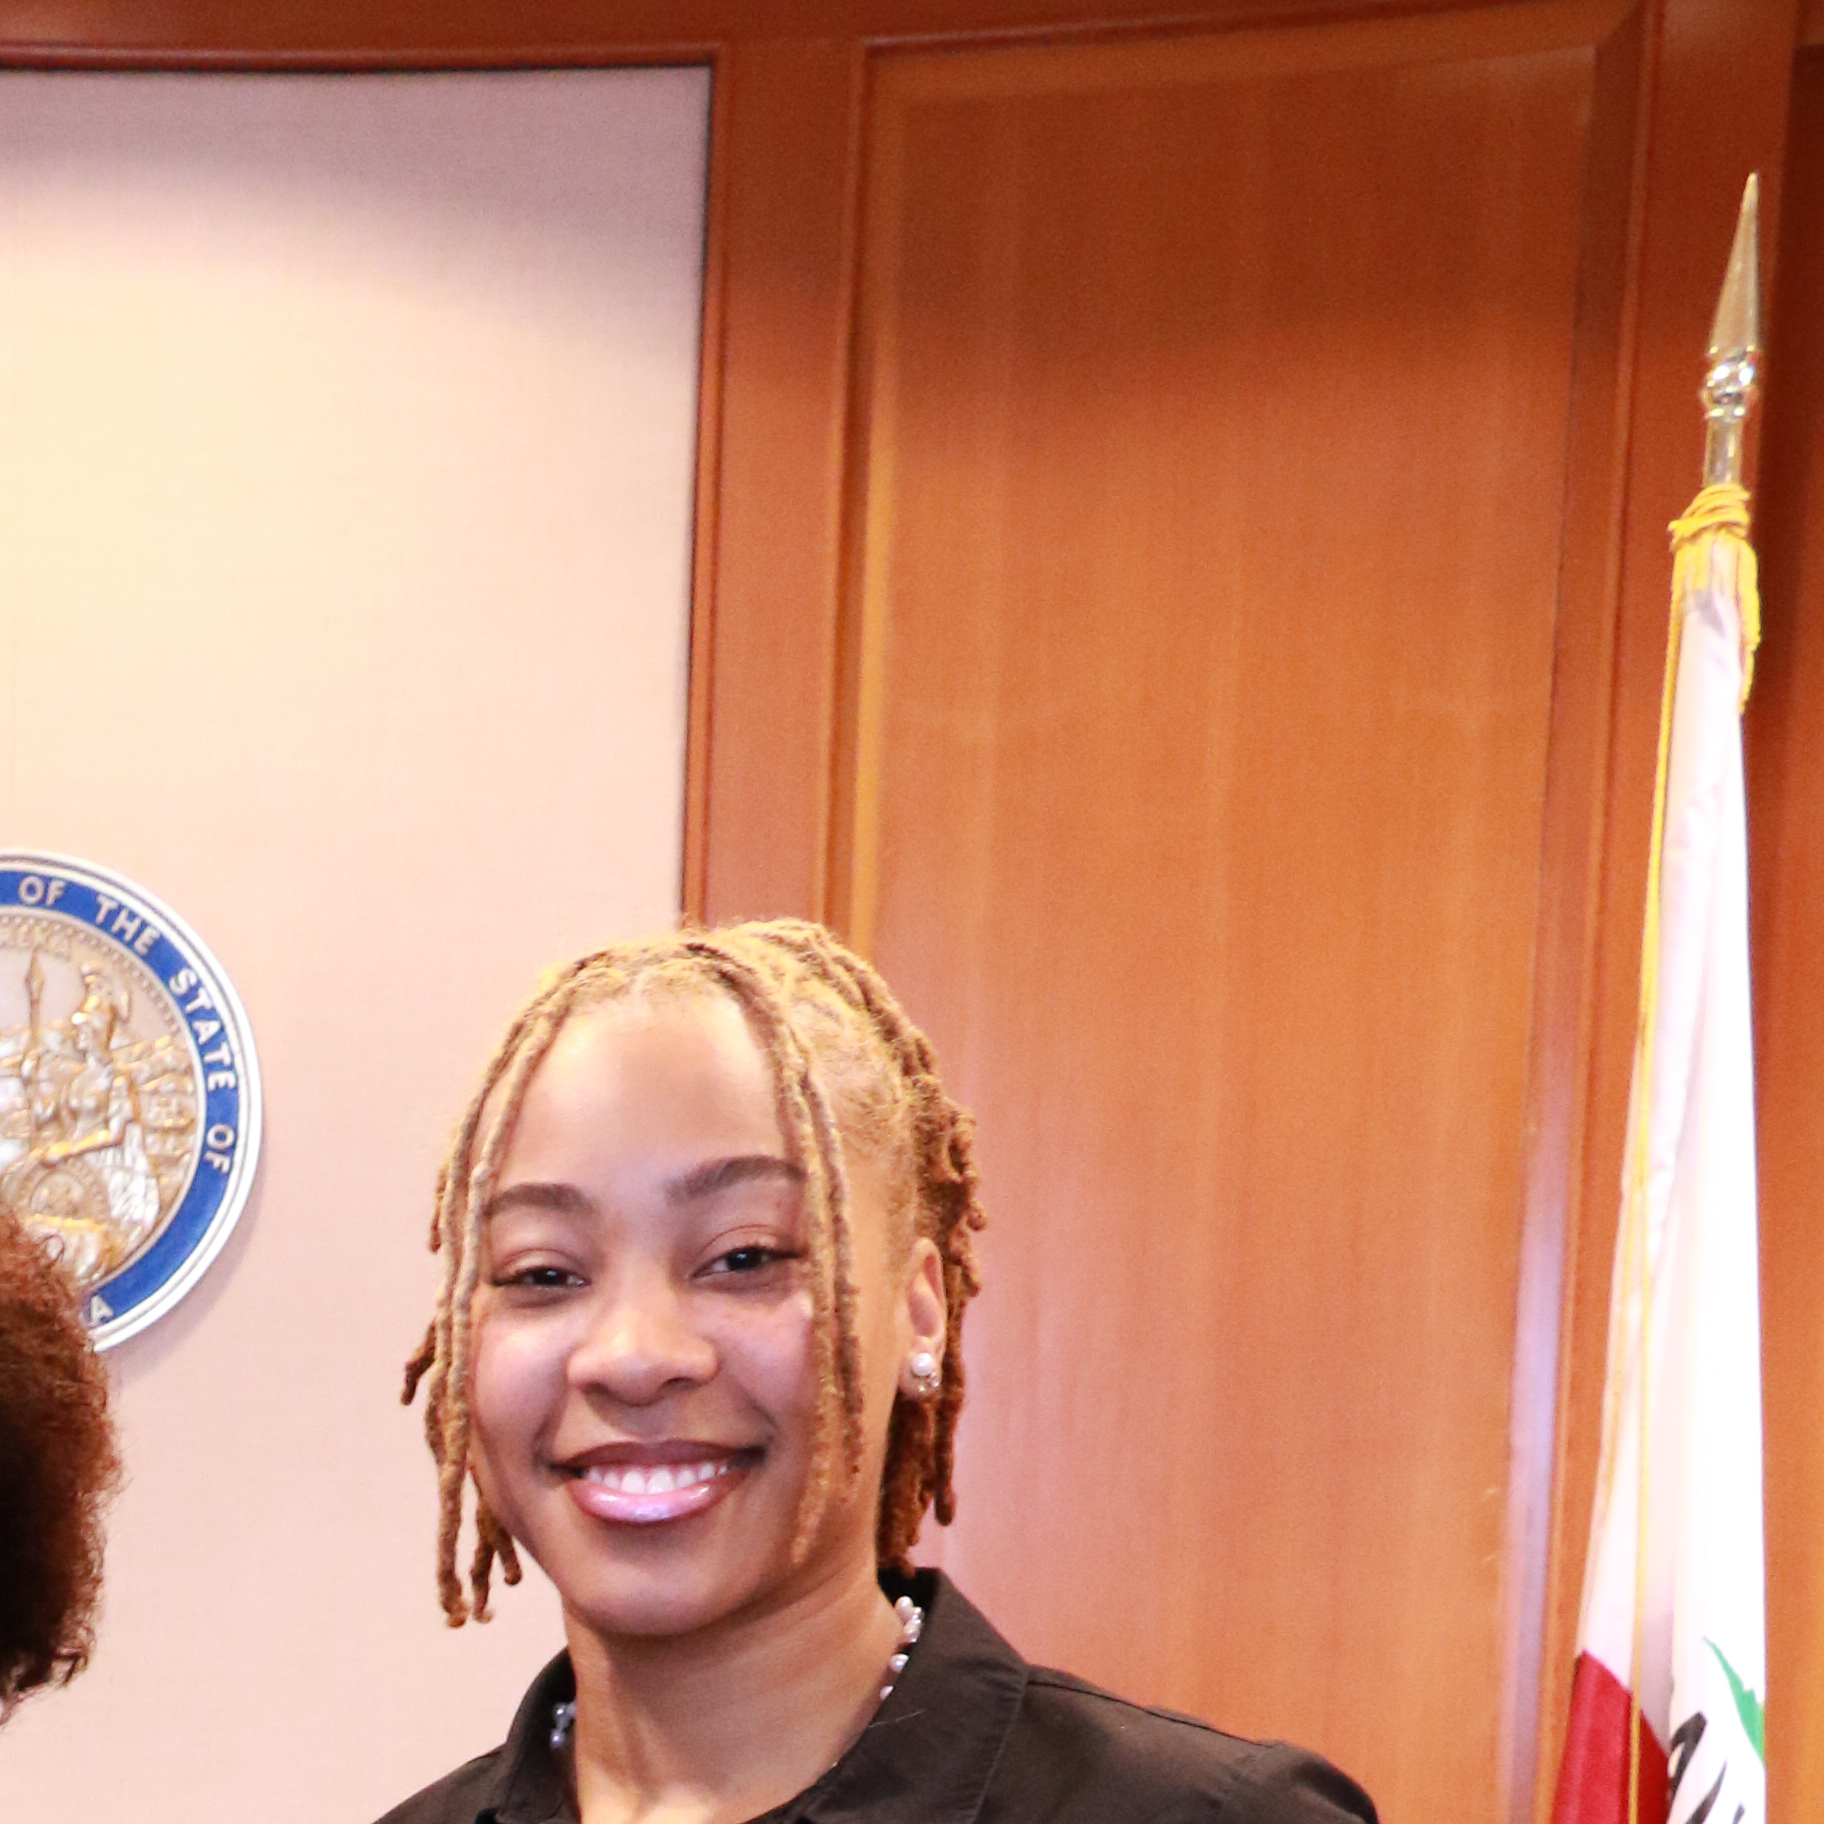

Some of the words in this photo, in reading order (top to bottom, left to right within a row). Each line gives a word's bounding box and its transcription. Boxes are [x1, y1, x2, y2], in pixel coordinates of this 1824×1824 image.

[19, 876, 66, 906] OF
[96, 895, 160, 955] THE
[169, 968, 238, 1092] STATE
[207, 1123, 234, 1174] OF
